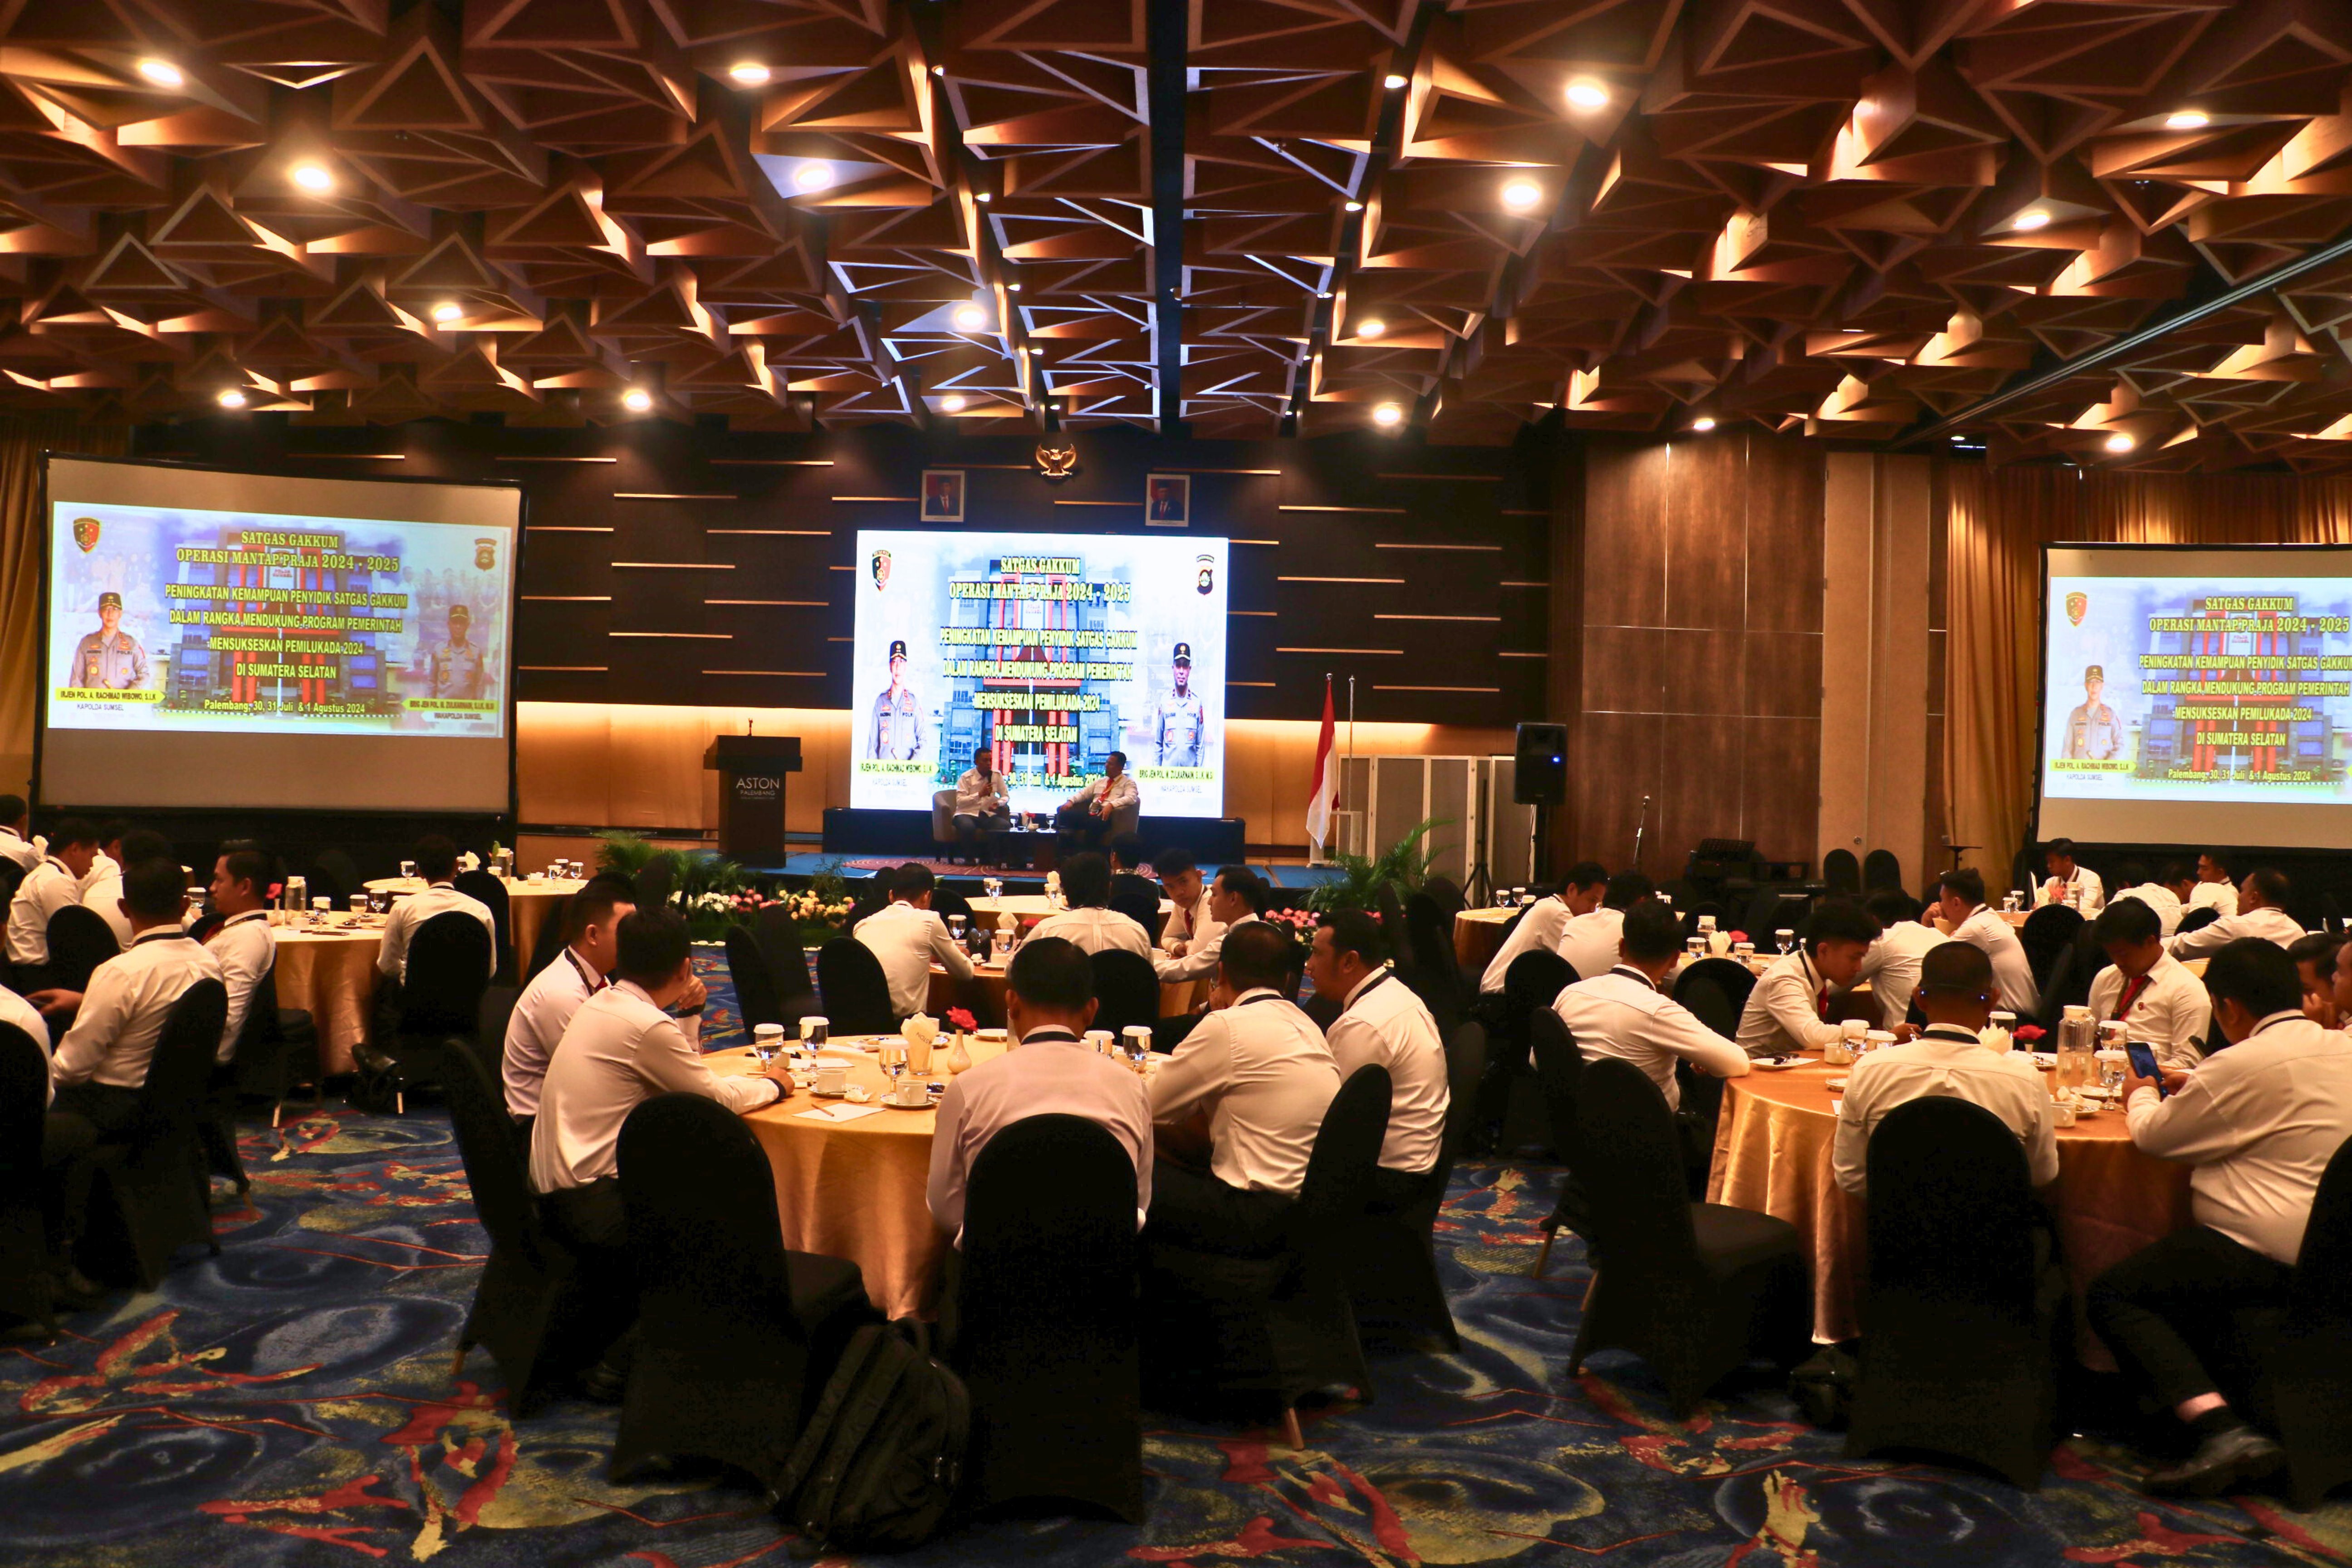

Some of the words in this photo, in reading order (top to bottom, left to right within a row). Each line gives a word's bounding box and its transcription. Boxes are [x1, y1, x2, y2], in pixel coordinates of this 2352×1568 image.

[241, 530, 285, 545] SATGAS
[289, 534, 339, 548] GAKKUM
[176, 548, 229, 564] OPERASI
[232, 551, 279, 566] MANTAP
[283, 554, 318, 567] PRAJA
[322, 554, 354, 569] 2024
[367, 556, 399, 572] 2025
[1001, 556, 1038, 574] SATGAS
[1039, 557, 1081, 575] GAKKUM
[165, 583, 229, 599] PENINGKATAN
[232, 587, 288, 602] KEMAMPUAN
[291, 589, 332, 604] PENYIDIK
[334, 592, 367, 606] SATGAS
[370, 593, 407, 608] GAKKUM
[949, 581, 991, 599] OPERASI
[993, 582, 1031, 600] MANTAP
[1034, 583, 1063, 601] PRAJA
[1066, 582, 1093, 602] 2024
[1104, 583, 1131, 603] 2025
[2205, 597, 2244, 611] SATGAS
[2247, 597, 2293, 611] GAKKUM
[170, 609, 200, 623] DALAM
[203, 611, 240, 625] RANGKA
[243, 612, 299, 627] MENDUKUNG
[303, 615, 344, 629] PROGRAM
[347, 617, 402, 632] PEMERINTAH
[2149, 617, 2194, 631] OPERASI
[2196, 618, 2238, 632] MANTAP
[2241, 618, 2274, 632] PRAJA
[2277, 617, 2308, 632] 2024
[2319, 617, 2350, 633] 2025
[210, 637, 283, 652] MENSUKSESKAN
[285, 640, 340, 654] PEMILUKADA
[343, 642, 363, 655] 2024
[940, 627, 991, 646] PENINGKATAN
[993, 628, 1038, 647] KEMAMPUAN
[1040, 629, 1074, 647] PENYIDIK
[1076, 630, 1104, 648] SATGAS
[1106, 630, 1137, 649] GAKKUM
[236, 663, 245, 676] DI
[248, 663, 295, 677] SUMATERA
[298, 665, 336, 679] SELATAN
[943, 659, 967, 677] DALAM
[969, 660, 998, 678] RANGKA
[1001, 661, 1048, 679] MENDUKUNG
[1049, 662, 1085, 680] PROGRAM
[1087, 662, 1133, 681] PEMERINTAH
[2139, 655, 2193, 669] PENINGKATAN
[2195, 656, 2244, 669] KEMAMPUAN
[2247, 656, 2285, 670] PENYIDIK
[2287, 656, 2318, 670] SATGAS
[2142, 680, 2168, 694] DALAM
[2170, 681, 2201, 694] RANGKA
[2205, 681, 2254, 695] MENDUKUNG
[2257, 682, 2296, 696] PROGRAM
[2298, 682, 2350, 696] PEMERINTAH
[267, 701, 276, 711] 31
[279, 701, 293, 712] Juli
[298, 702, 304, 711] &
[307, 703, 311, 712] 1
[313, 703, 344, 715] Agustus
[347, 704, 365, 713] 2024
[974, 691, 1034, 710] MENSUKSESKAN
[1035, 694, 1080, 711] PEMILUKADA
[1083, 694, 1100, 712] 2024
[2175, 706, 2238, 720] MENSUKSESKAN
[2240, 707, 2291, 720] PEMILUKADA
[2293, 708, 2312, 720] 2024
[995, 724, 1003, 742] DI
[1004, 725, 1044, 742] SUMATERA
[1045, 725, 1078, 743] SELATAN
[2196, 732, 2205, 745] DI
[2206, 732, 2248, 745] SUMATERA
[2250, 733, 2286, 746] SELATAN
[735, 777, 779, 789] ASTON
[1019, 771, 1027, 786] 31
[1045, 773, 1050, 786] &
[1057, 773, 1083, 788] Agustus
[2223, 769, 2230, 779] 31
[2232, 770, 2244, 780] Juli
[2249, 770, 2254, 779] &
[2256, 770, 2260, 779] 1
[2262, 771, 2291, 783] Agustus
[2293, 771, 2311, 781] 2024
